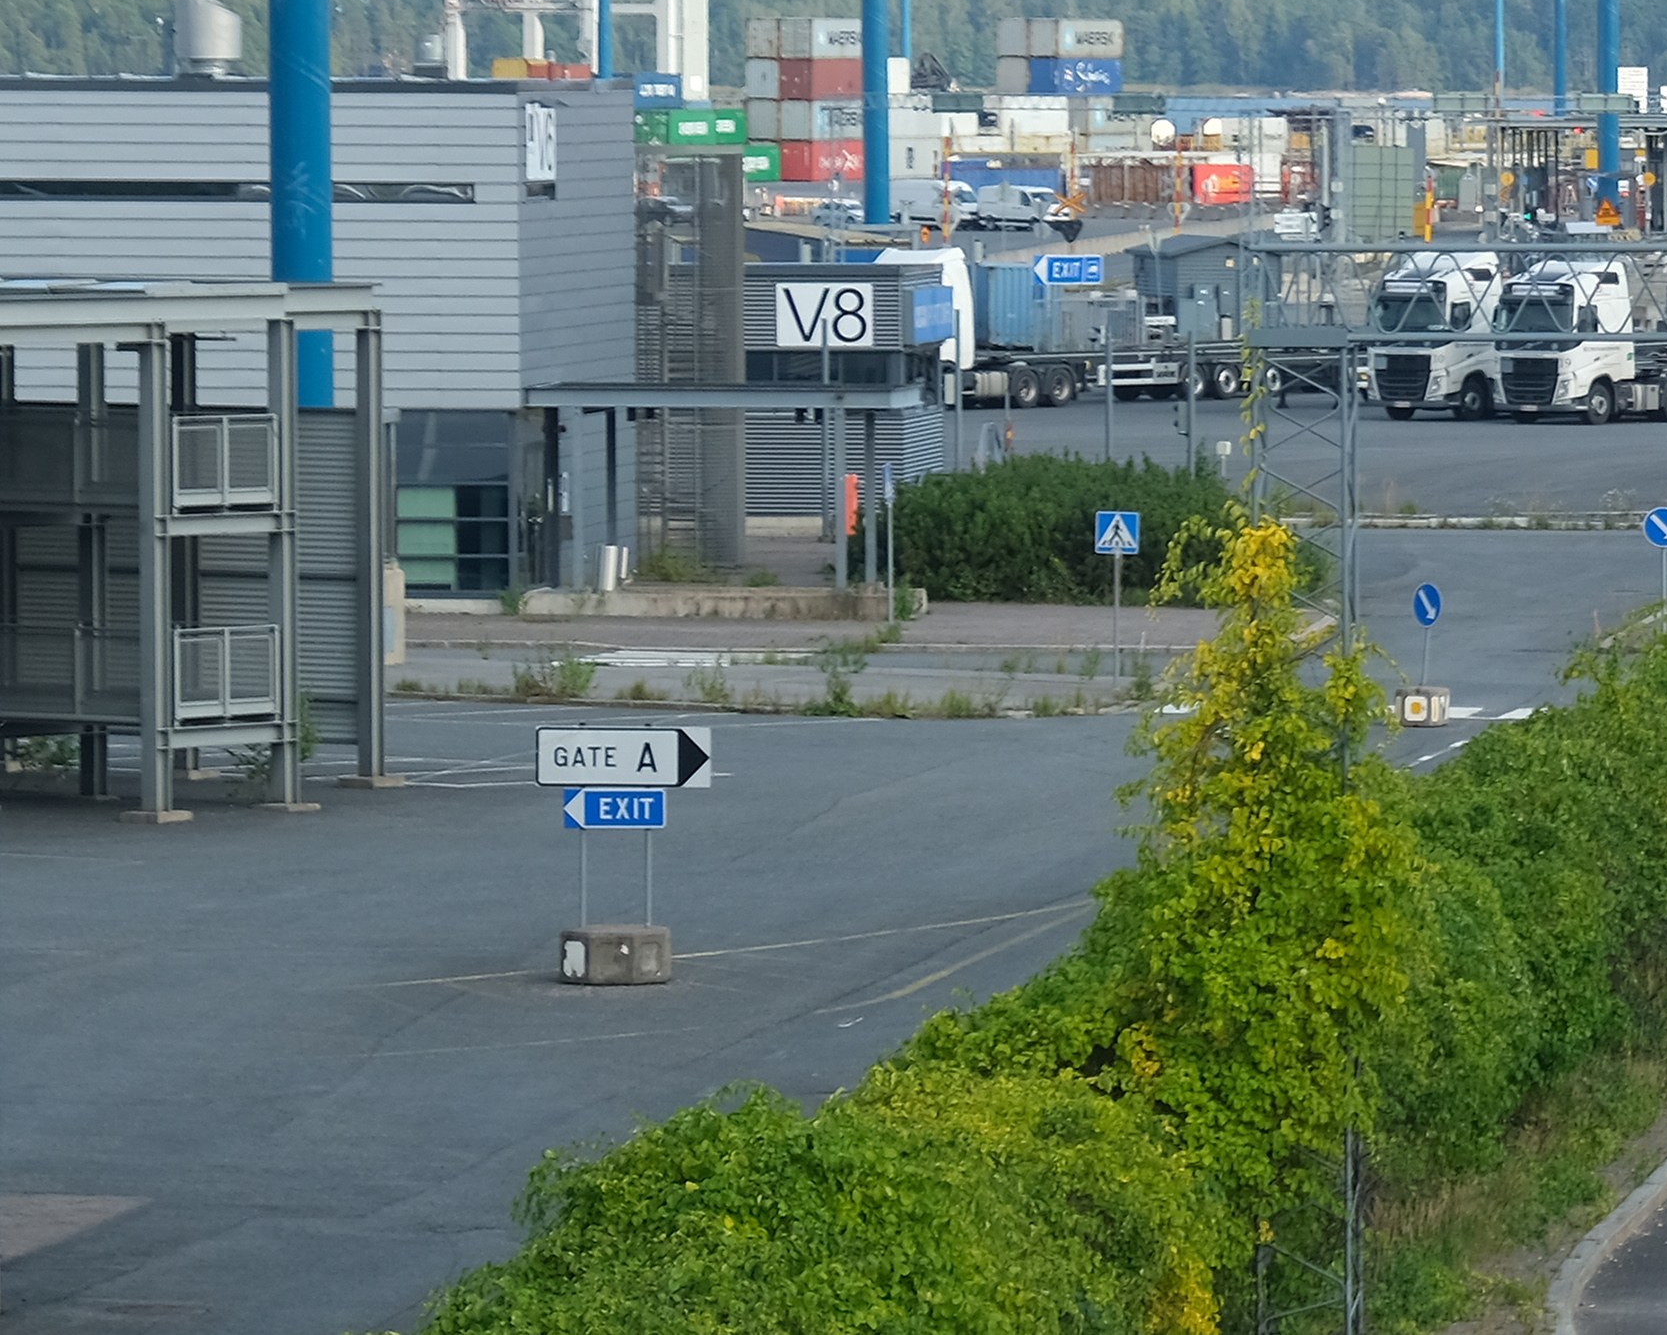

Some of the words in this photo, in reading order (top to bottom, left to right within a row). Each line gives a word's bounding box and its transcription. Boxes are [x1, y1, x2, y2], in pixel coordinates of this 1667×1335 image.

[1052, 262, 1080, 278] EXIT
[783, 288, 867, 342] V8
[554, 747, 617, 767] GATE
[637, 742, 657, 772] A
[599, 797, 654, 819] EXIT
